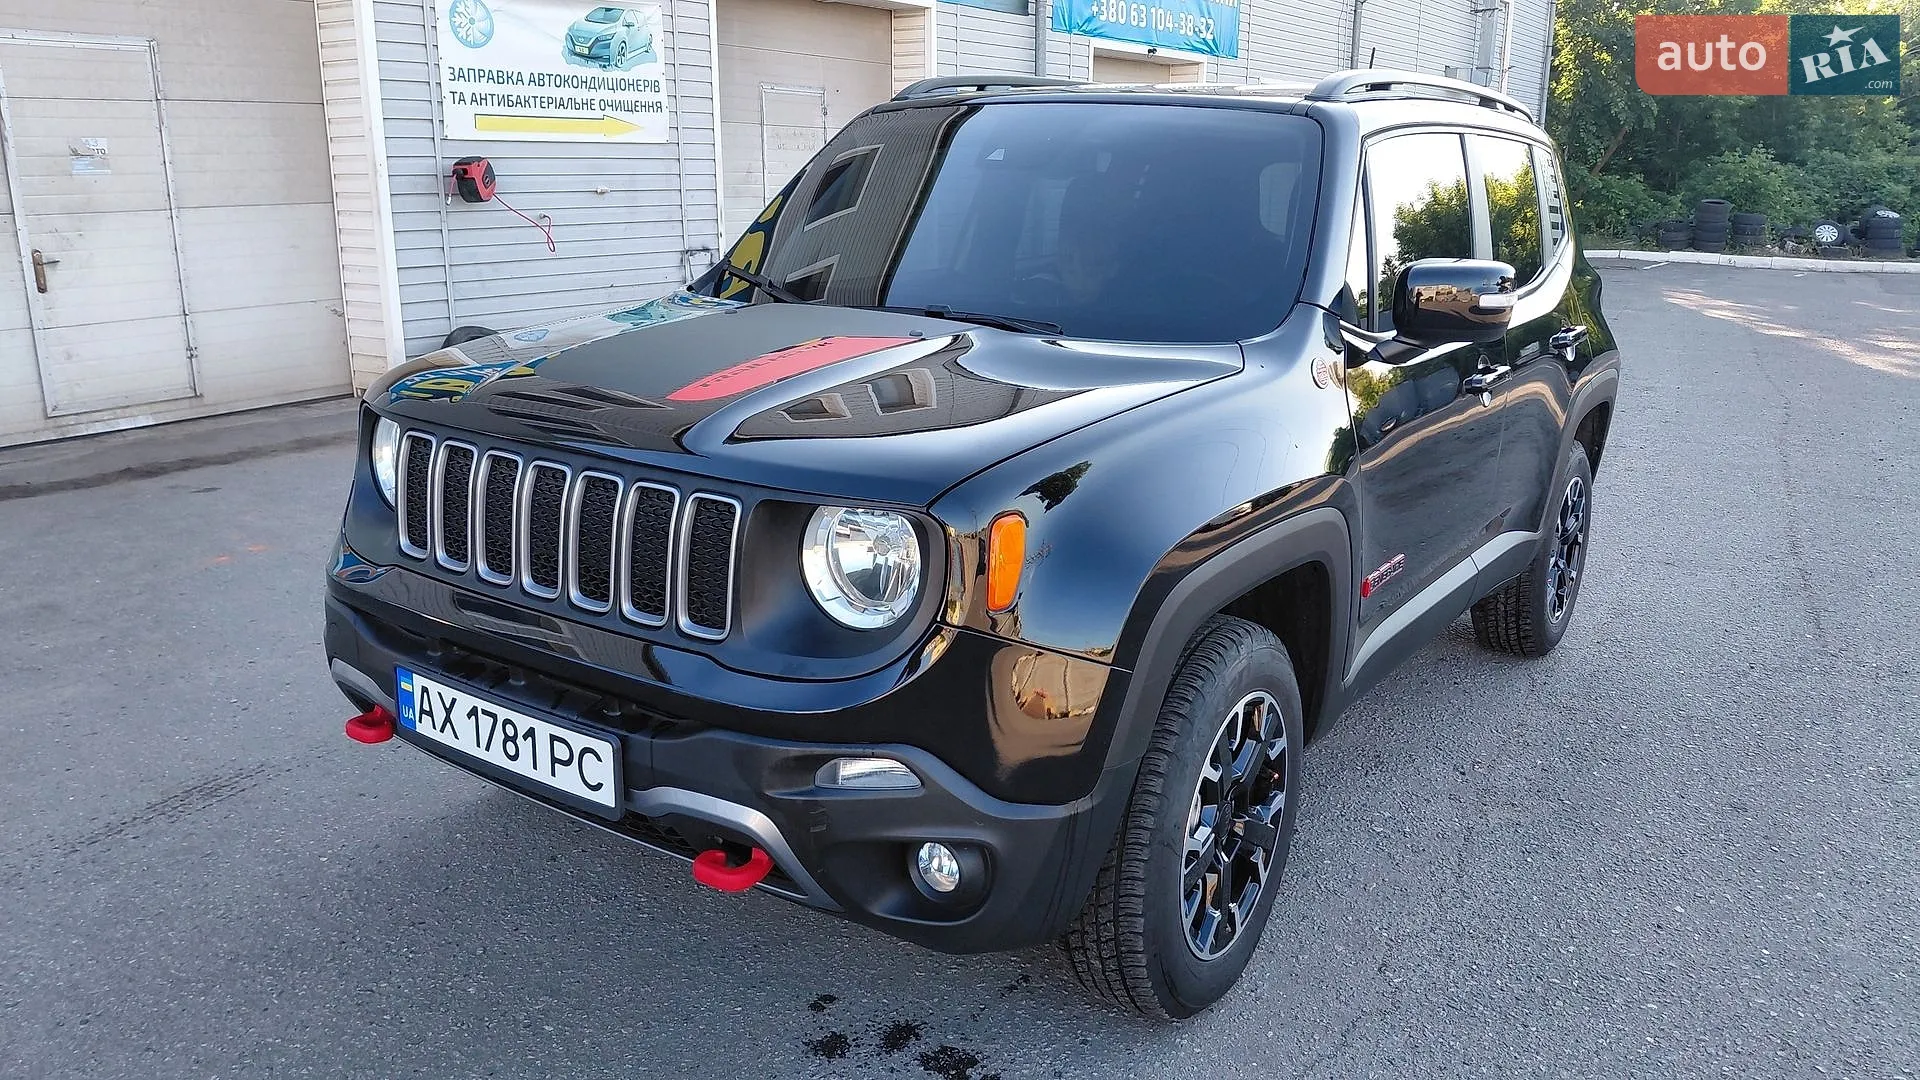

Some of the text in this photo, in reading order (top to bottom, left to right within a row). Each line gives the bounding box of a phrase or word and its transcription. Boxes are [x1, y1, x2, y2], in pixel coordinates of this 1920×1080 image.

[1091, 0, 1215, 40] +380 63 104-38-32
[448, 66, 660, 93] ЗАПРАВКА АВТОКОНДИЦІОНЕРІВ
[449, 91, 663, 114] ТА АНТИБАКТЕРІАЛЬНЕ ОЧИЩЕННЯ
[402, 706, 415, 721] UA
[418, 685, 604, 793] AX 1781 PC
